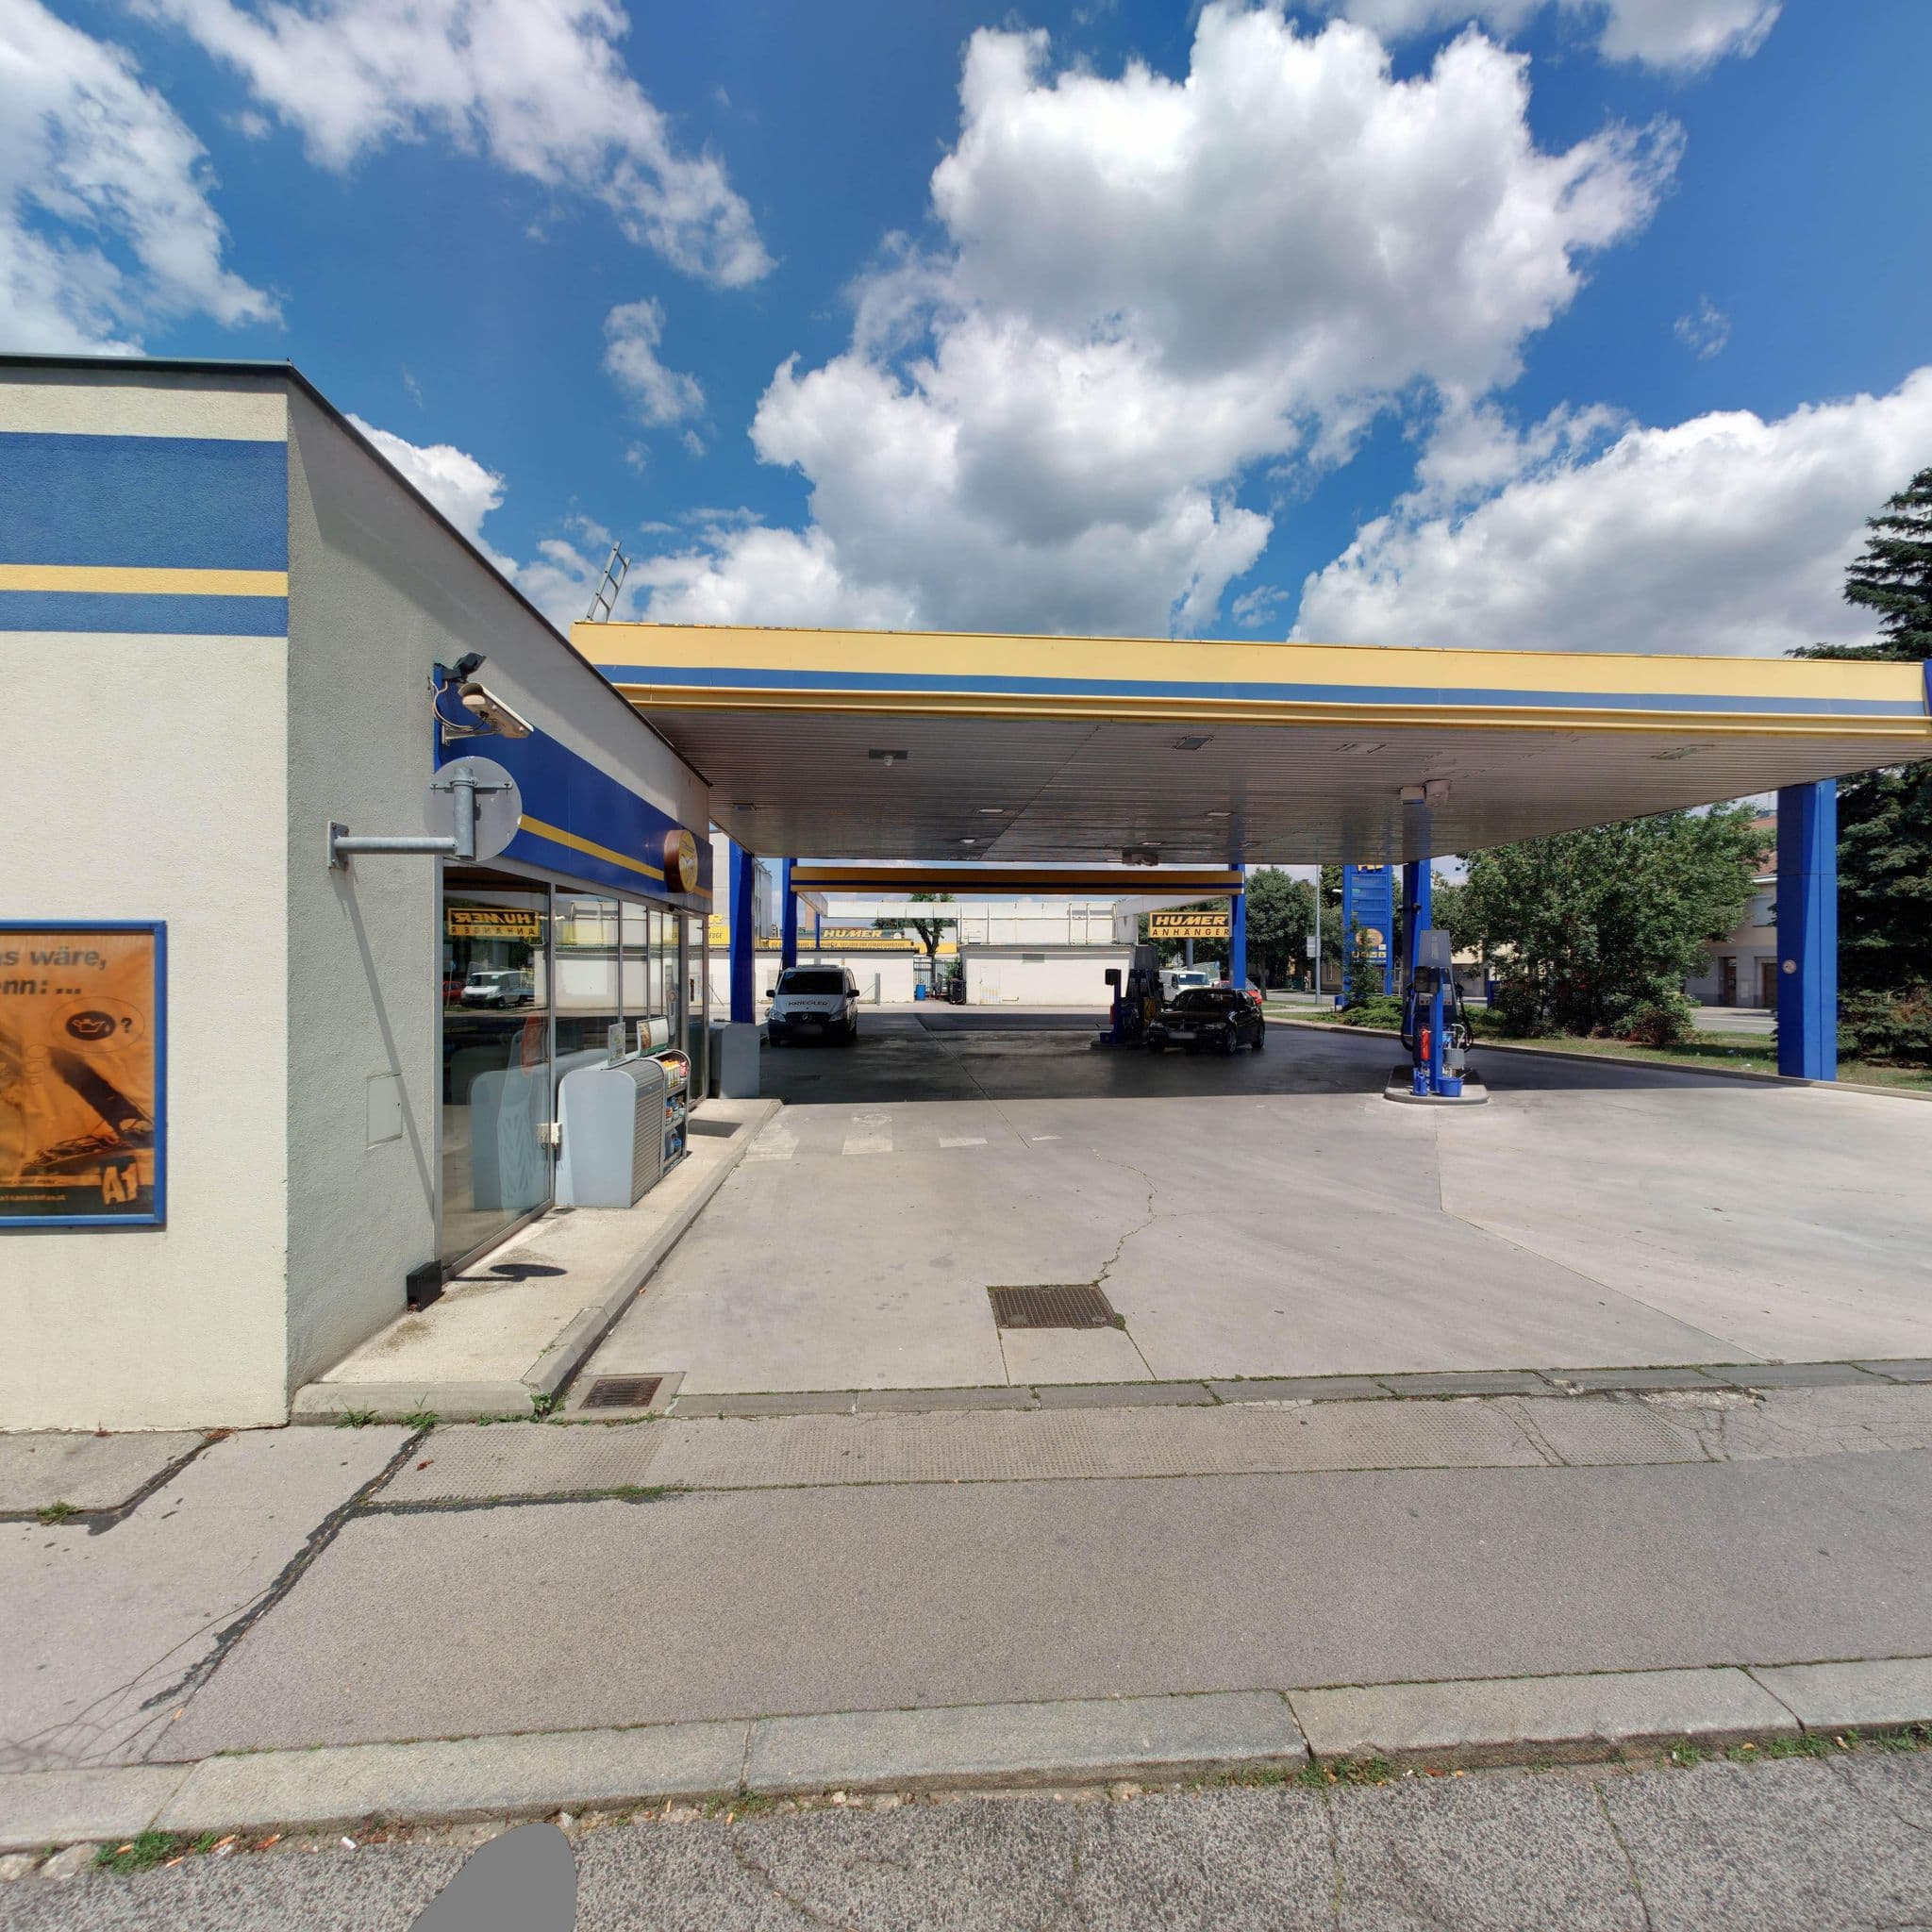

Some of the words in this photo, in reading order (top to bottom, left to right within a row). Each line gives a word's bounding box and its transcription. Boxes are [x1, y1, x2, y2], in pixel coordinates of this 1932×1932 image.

[1156, 916, 1227, 924] HUMER
[824, 929, 883, 938] HUMER
[1152, 927, 1230, 936] ANHÄNGER
[0, 950, 20, 966] s
[30, 945, 107, 971] wäre,
[0, 979, 48, 995] nn:
[102, 1162, 138, 1206] A1
